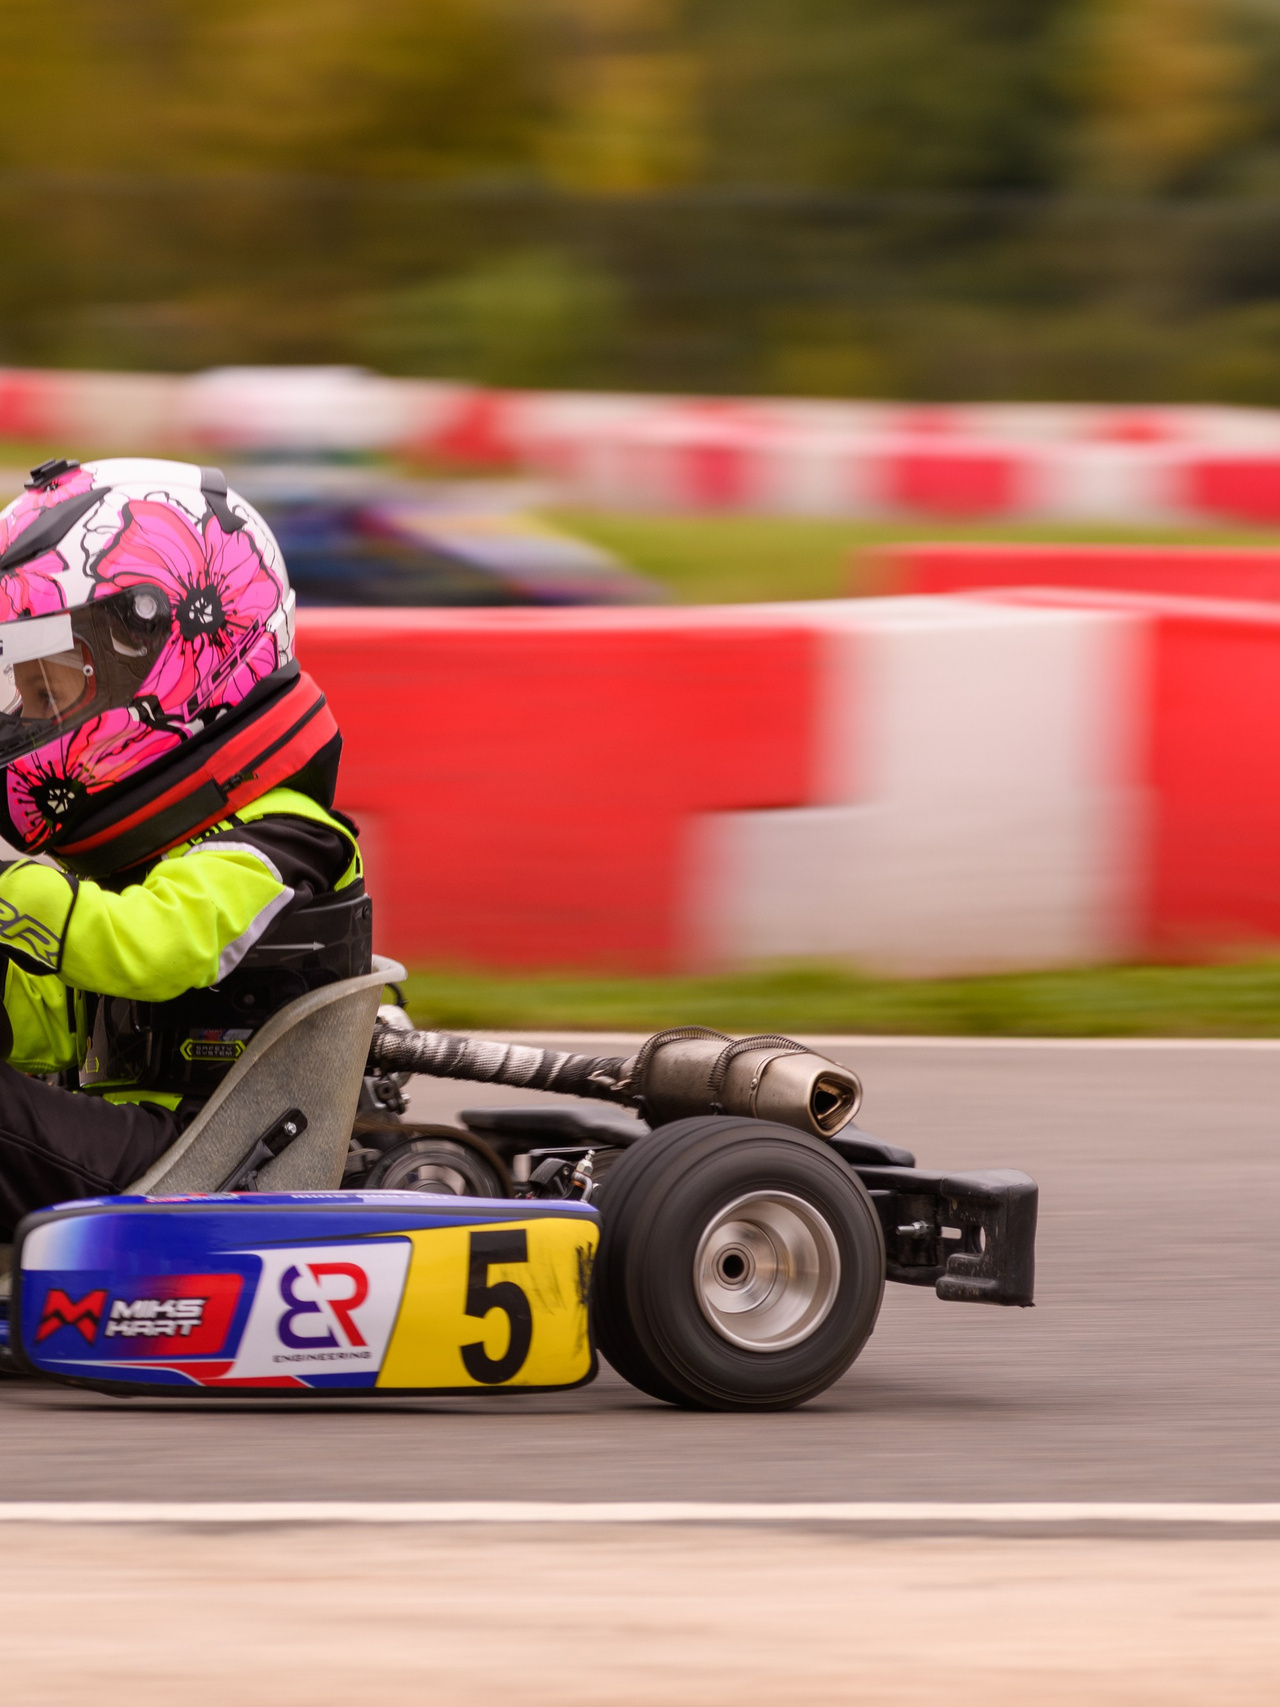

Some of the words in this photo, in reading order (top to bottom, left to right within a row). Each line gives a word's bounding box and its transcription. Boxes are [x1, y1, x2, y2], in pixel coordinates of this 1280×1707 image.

[110, 1299, 207, 1319] MIKS
[459, 1229, 533, 1384] 5
[104, 1319, 202, 1337] KART
[272, 1351, 372, 1363] ENGINEERING
